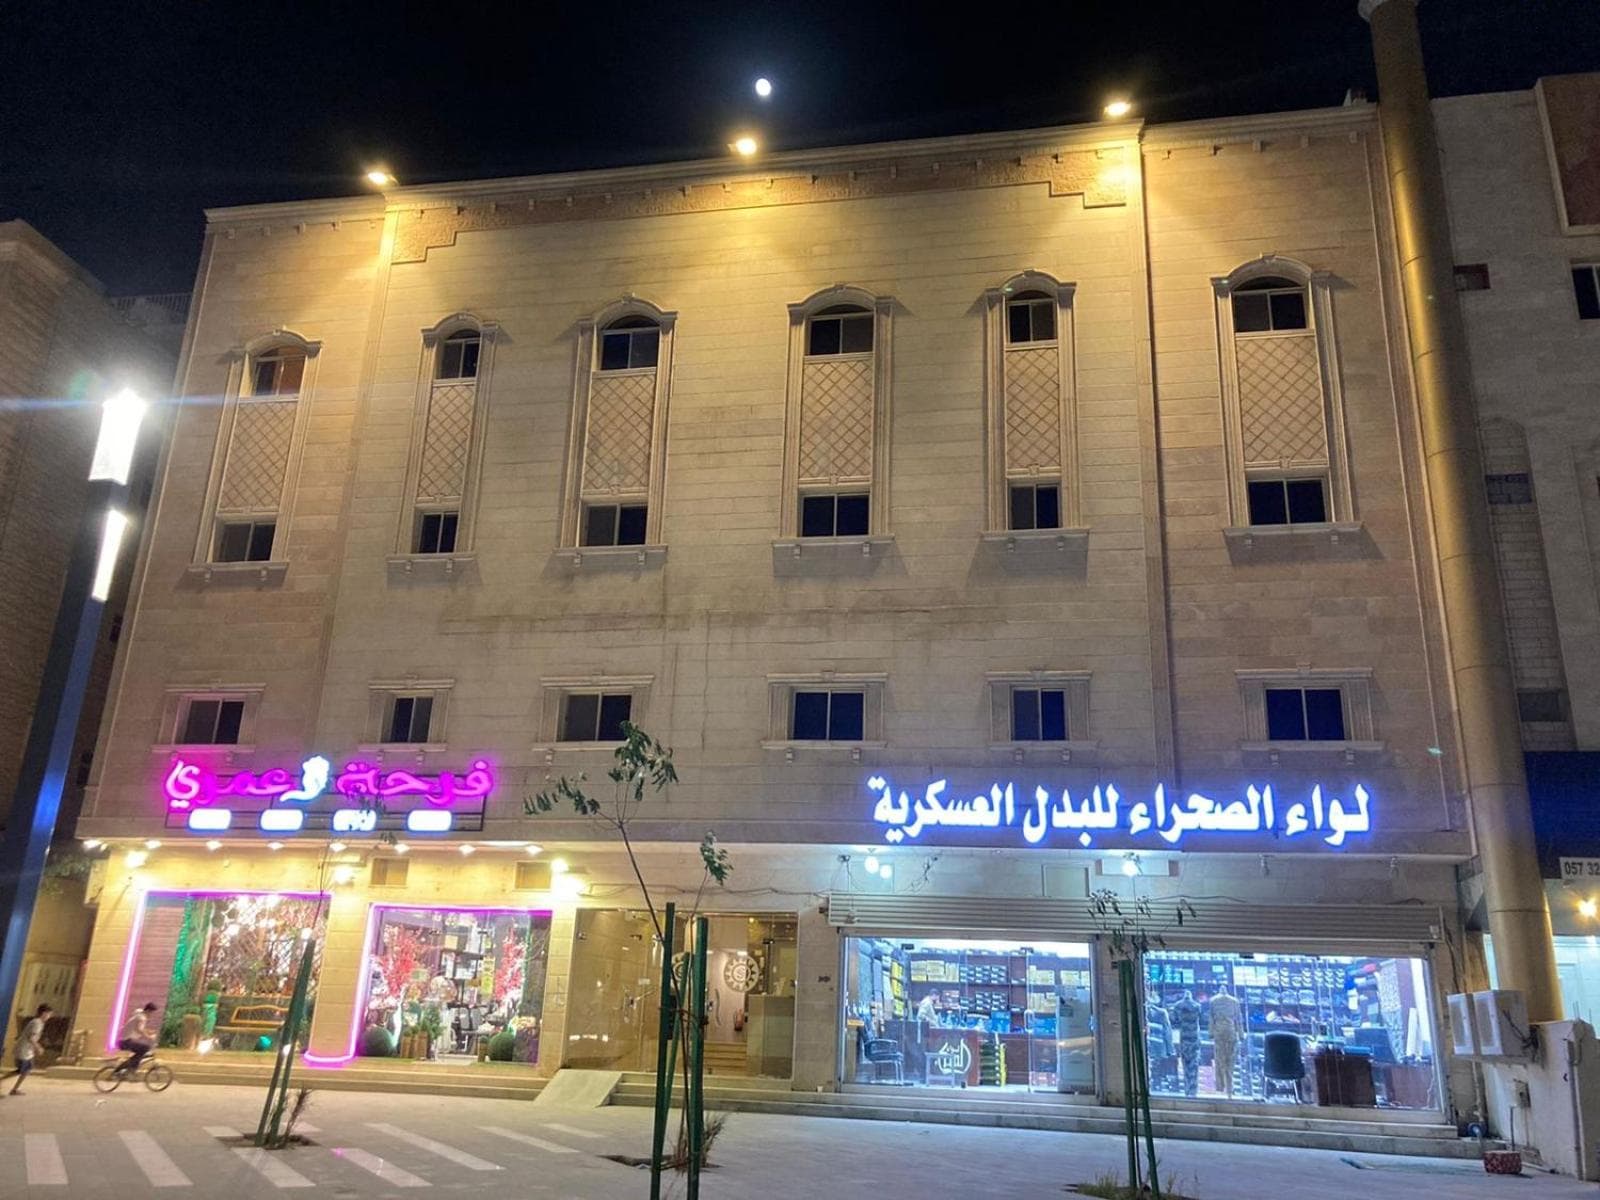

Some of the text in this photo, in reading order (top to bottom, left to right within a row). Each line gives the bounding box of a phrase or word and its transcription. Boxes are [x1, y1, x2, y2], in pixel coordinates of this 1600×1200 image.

[336, 760, 493, 805] فرحة
[867, 776, 1369, 846] لواء الصحراء للبدل العسكرية
[1564, 861, 1583, 875] 057
